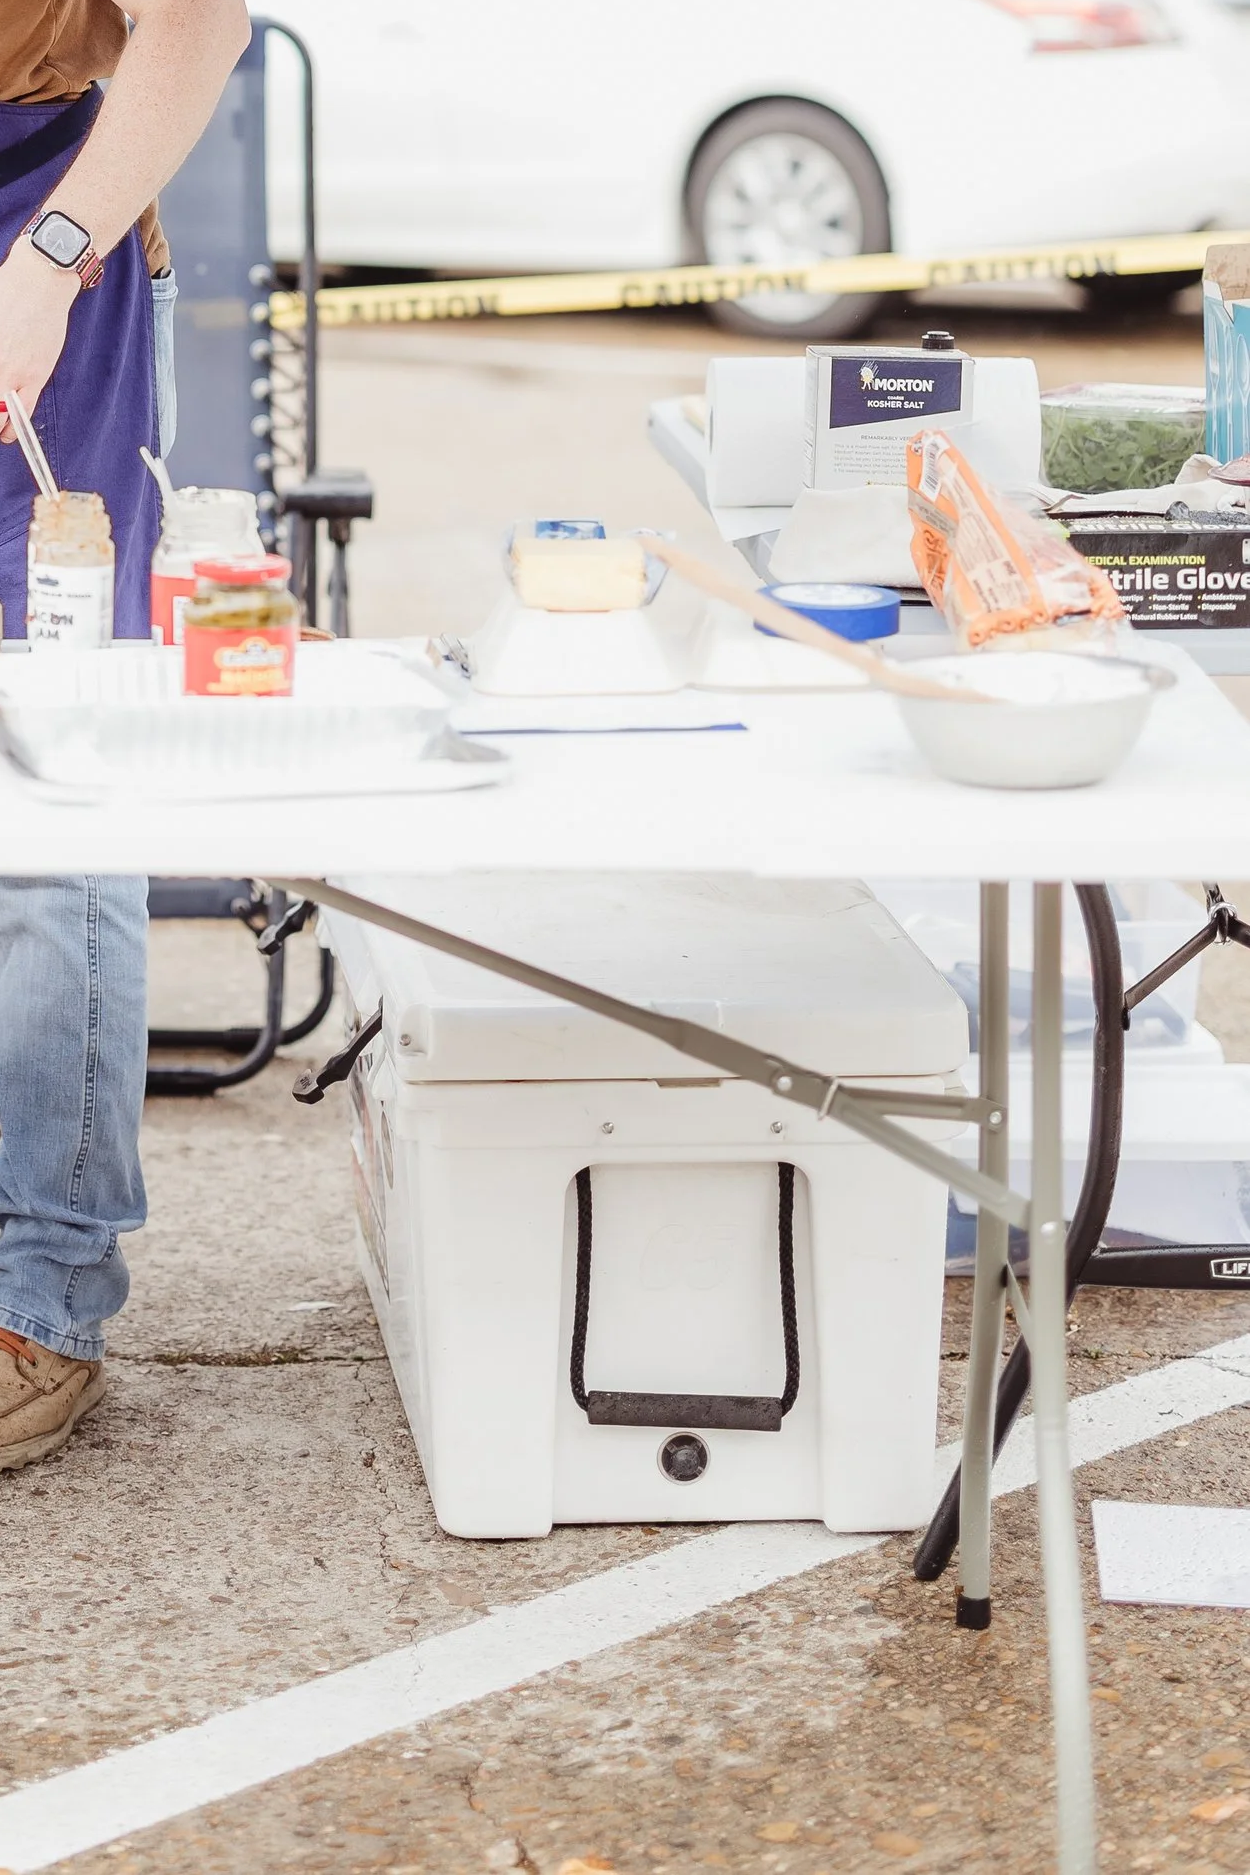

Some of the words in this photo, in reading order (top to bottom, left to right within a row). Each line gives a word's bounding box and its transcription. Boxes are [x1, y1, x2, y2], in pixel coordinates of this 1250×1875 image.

[927, 250, 1117, 287] CAUTION
[620, 271, 806, 307] CAUTION
[874, 378, 933, 392] MORTON
[867, 400, 902, 409] KOSHER
[903, 401, 925, 410] SALT
[1129, 555, 1205, 565] EXAMINATION
[1153, 593, 1193, 601] Powder-Free
[1202, 593, 1247, 601] Ambidextrous
[1153, 603, 1190, 611] Non-Sterile
[1201, 603, 1237, 612] Disposable
[1131, 613, 1156, 621] Natural
[1157, 613, 1179, 621] Rubber
[1180, 613, 1199, 621] Latex
[1222, 1262, 1250, 1275] LIF
